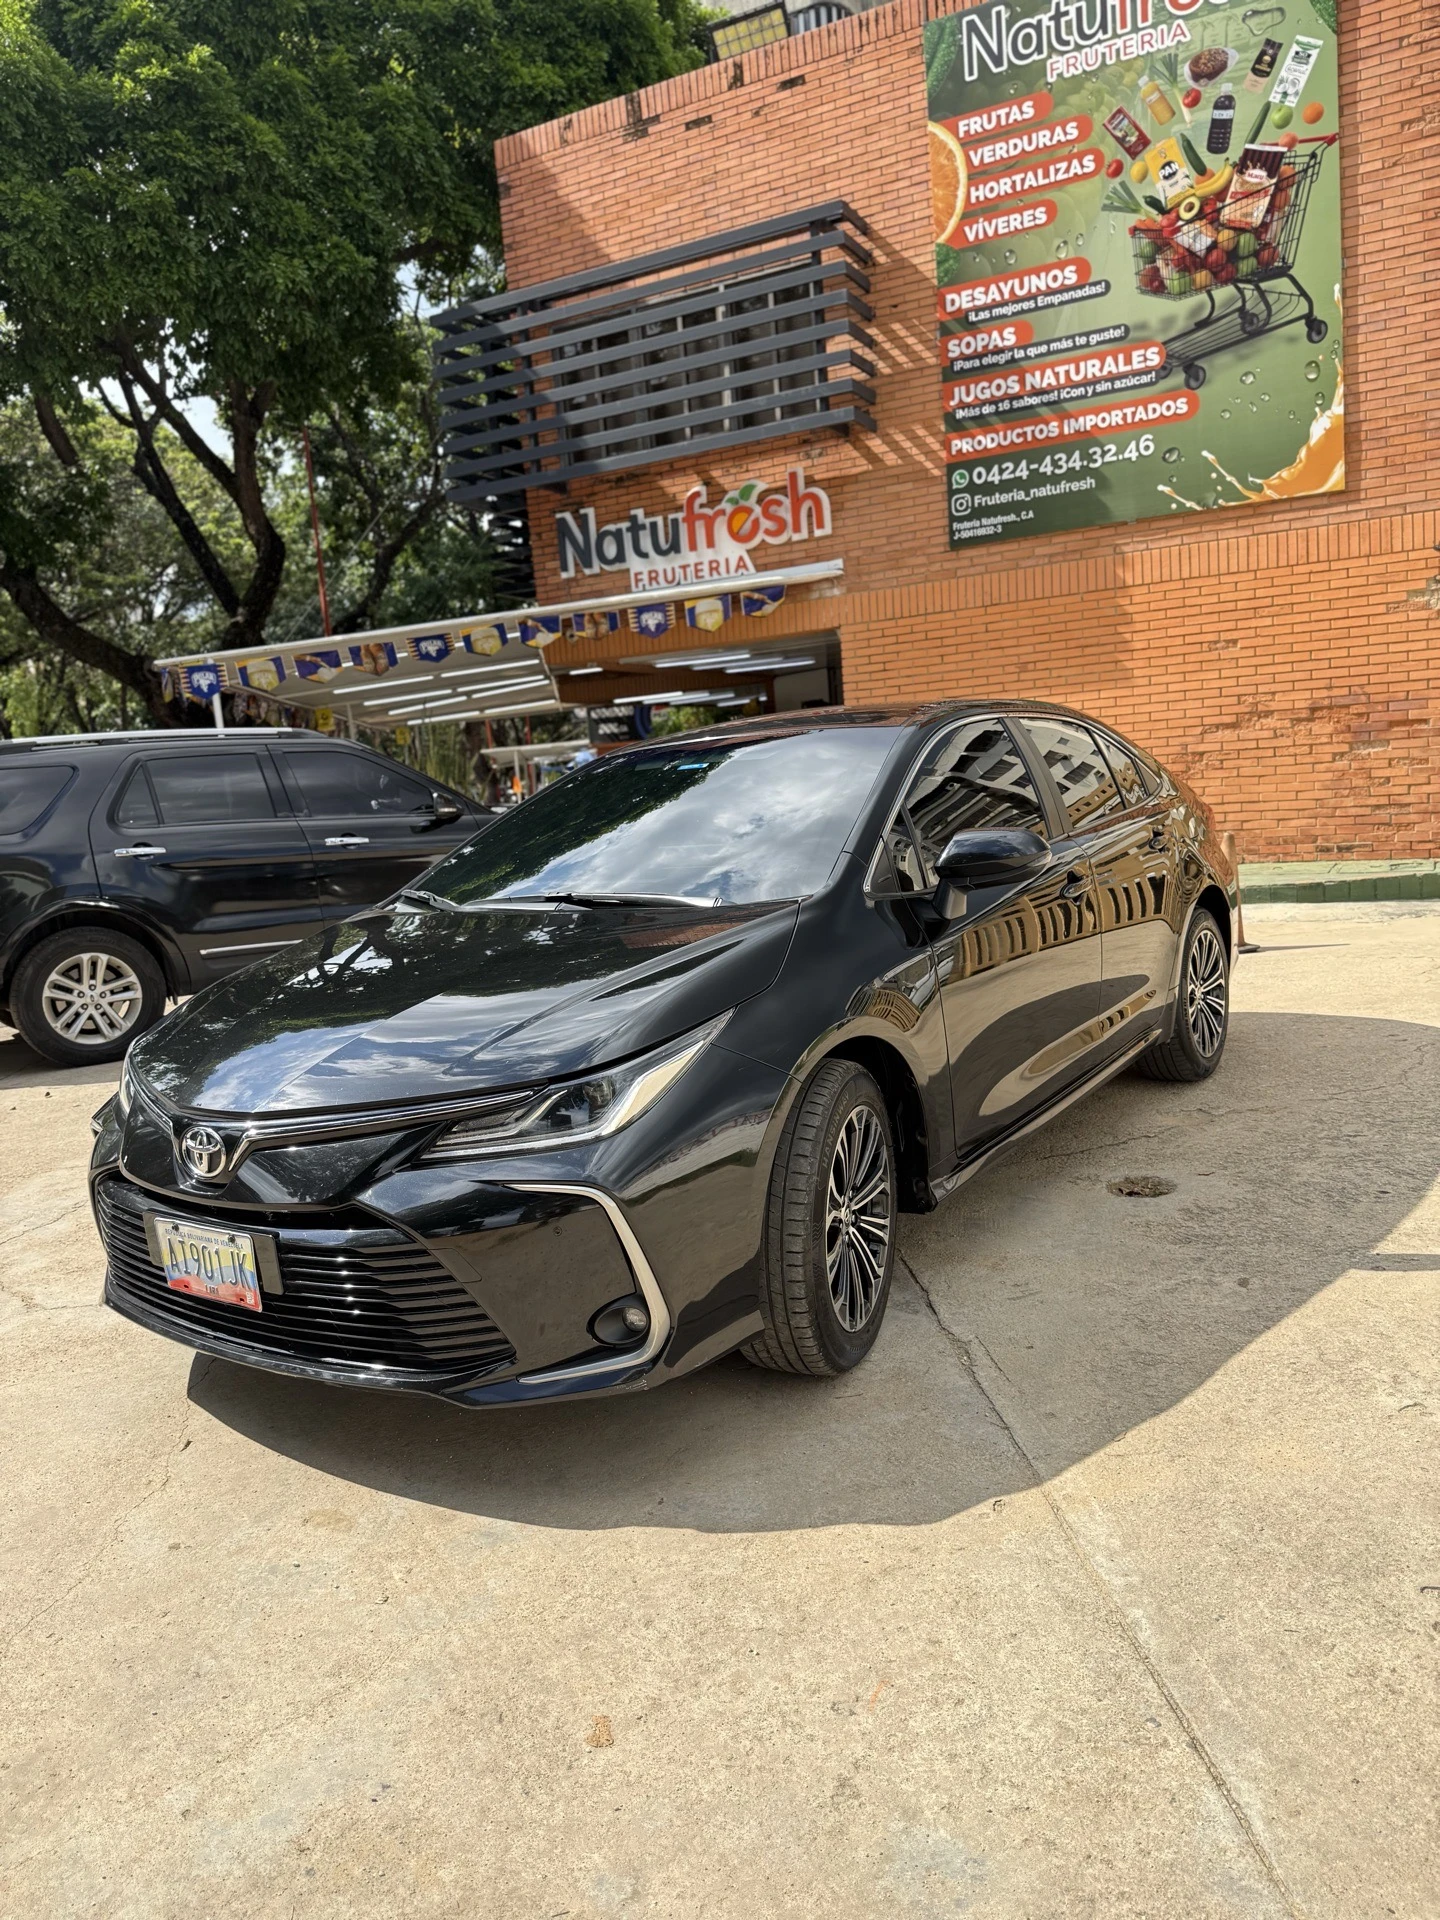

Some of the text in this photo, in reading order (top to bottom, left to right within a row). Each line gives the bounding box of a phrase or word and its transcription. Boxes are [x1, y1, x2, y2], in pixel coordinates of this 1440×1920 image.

[1048, 21, 1190, 80] FRUTERIA
[958, 101, 1035, 138] FRUTAS
[969, 122, 1079, 167] VERDURAS
[970, 155, 1096, 204] HORTALIZAS
[964, 207, 1048, 242] VÍVERES
[945, 265, 1078, 313] DESAYUNOS
[992, 300, 1036, 318] mejores
[1037, 282, 1106, 307] Empanadas!
[947, 327, 1017, 358] SOPAS
[982, 350, 1013, 366] elegir
[1013, 348, 1025, 358] la
[1026, 344, 1048, 358] que
[1050, 337, 1074, 351] más
[1075, 334, 1088, 345] te
[1089, 326, 1126, 344] guste!
[950, 347, 1161, 406] JUGOS NATURALES
[982, 403, 996, 415] de
[998, 400, 1011, 412] 16
[1012, 391, 1059, 408] sabores!
[1086, 384, 1094, 397] y
[1095, 379, 1112, 392] sin
[1114, 372, 1156, 389] azúcar!
[950, 397, 1189, 456] PRODUCTOS IMPORTADOS
[972, 433, 1155, 485] 0424-434.32.46
[974, 476, 1096, 508] Fruteria_natufresh
[556, 468, 831, 578] Natufresh
[633, 555, 750, 589] FRUTERIA
